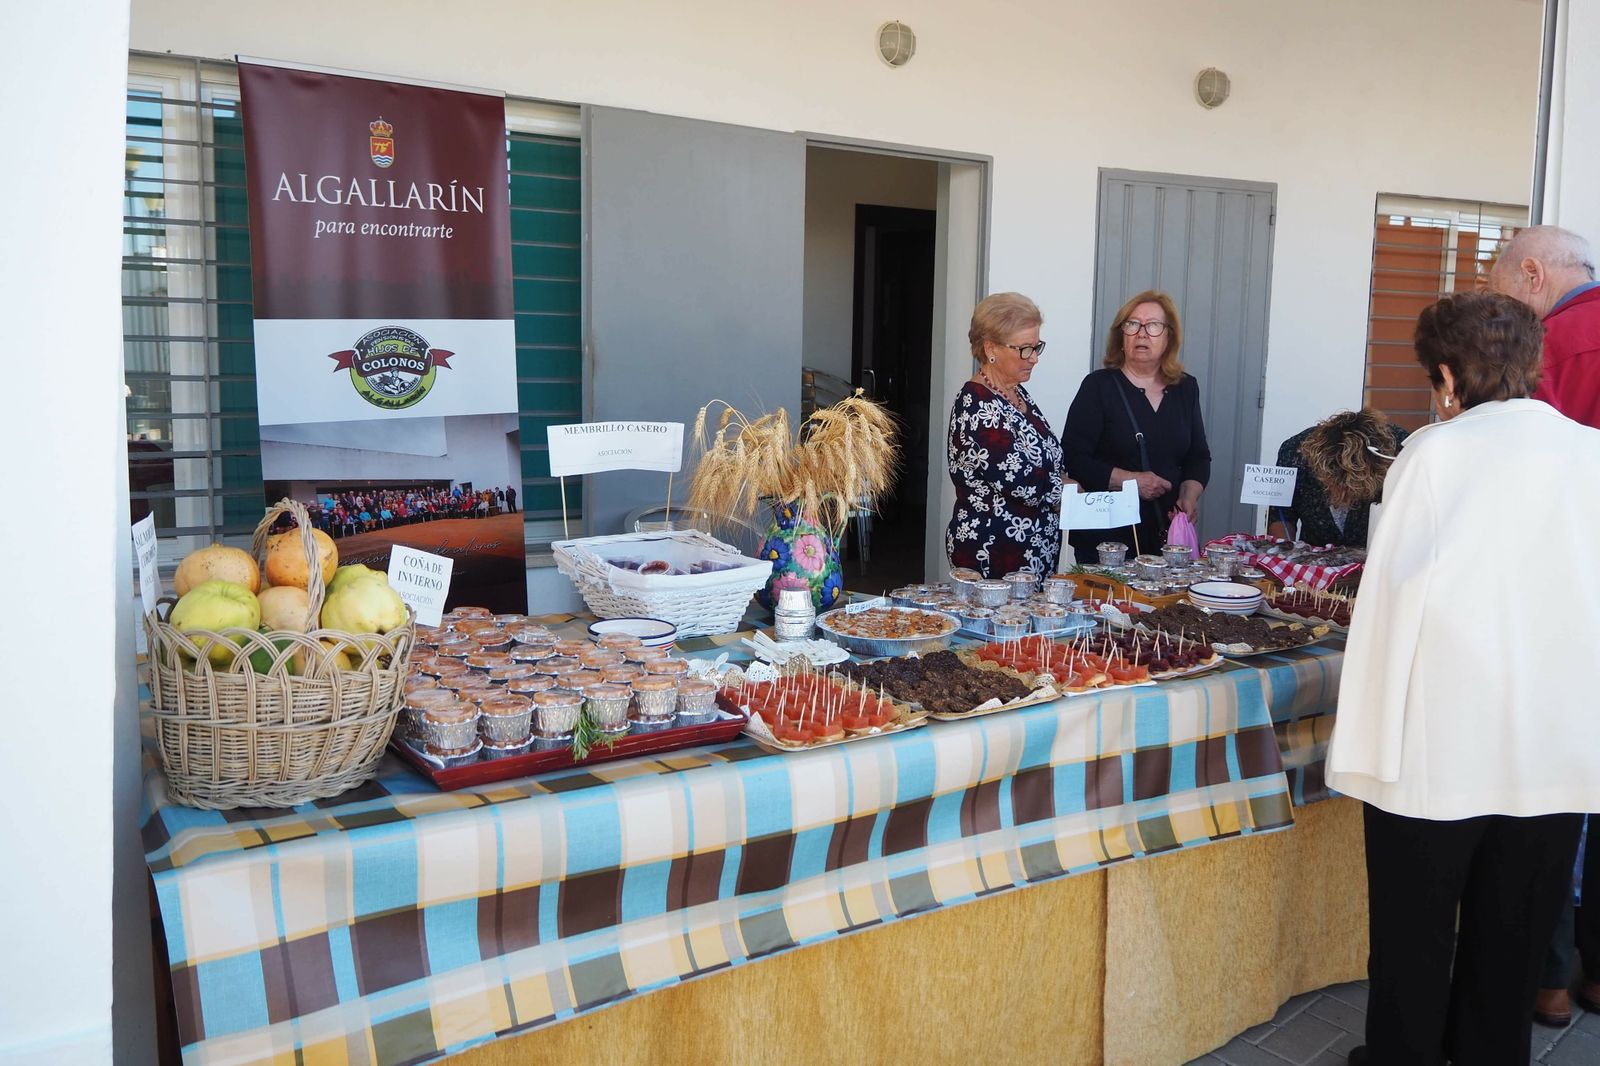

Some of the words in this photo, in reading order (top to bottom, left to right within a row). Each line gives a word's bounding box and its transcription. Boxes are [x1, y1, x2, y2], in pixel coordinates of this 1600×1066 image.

[272, 172, 484, 213] ALGALLARÍN
[314, 219, 355, 238] para
[361, 222, 453, 239] encontrarte
[367, 344, 398, 355] HIJOS
[402, 345, 419, 354] DE
[362, 357, 425, 372] COLONOS
[564, 424, 624, 435] MEMBRILLO
[627, 424, 668, 434] CASERO
[1263, 467, 1273, 475] DE
[1275, 468, 1294, 476] HIGO
[1254, 476, 1285, 484] CASERO
[404, 555, 430, 572] COÑA
[432, 562, 443, 576] DE
[398, 570, 443, 591] INVIERNO
